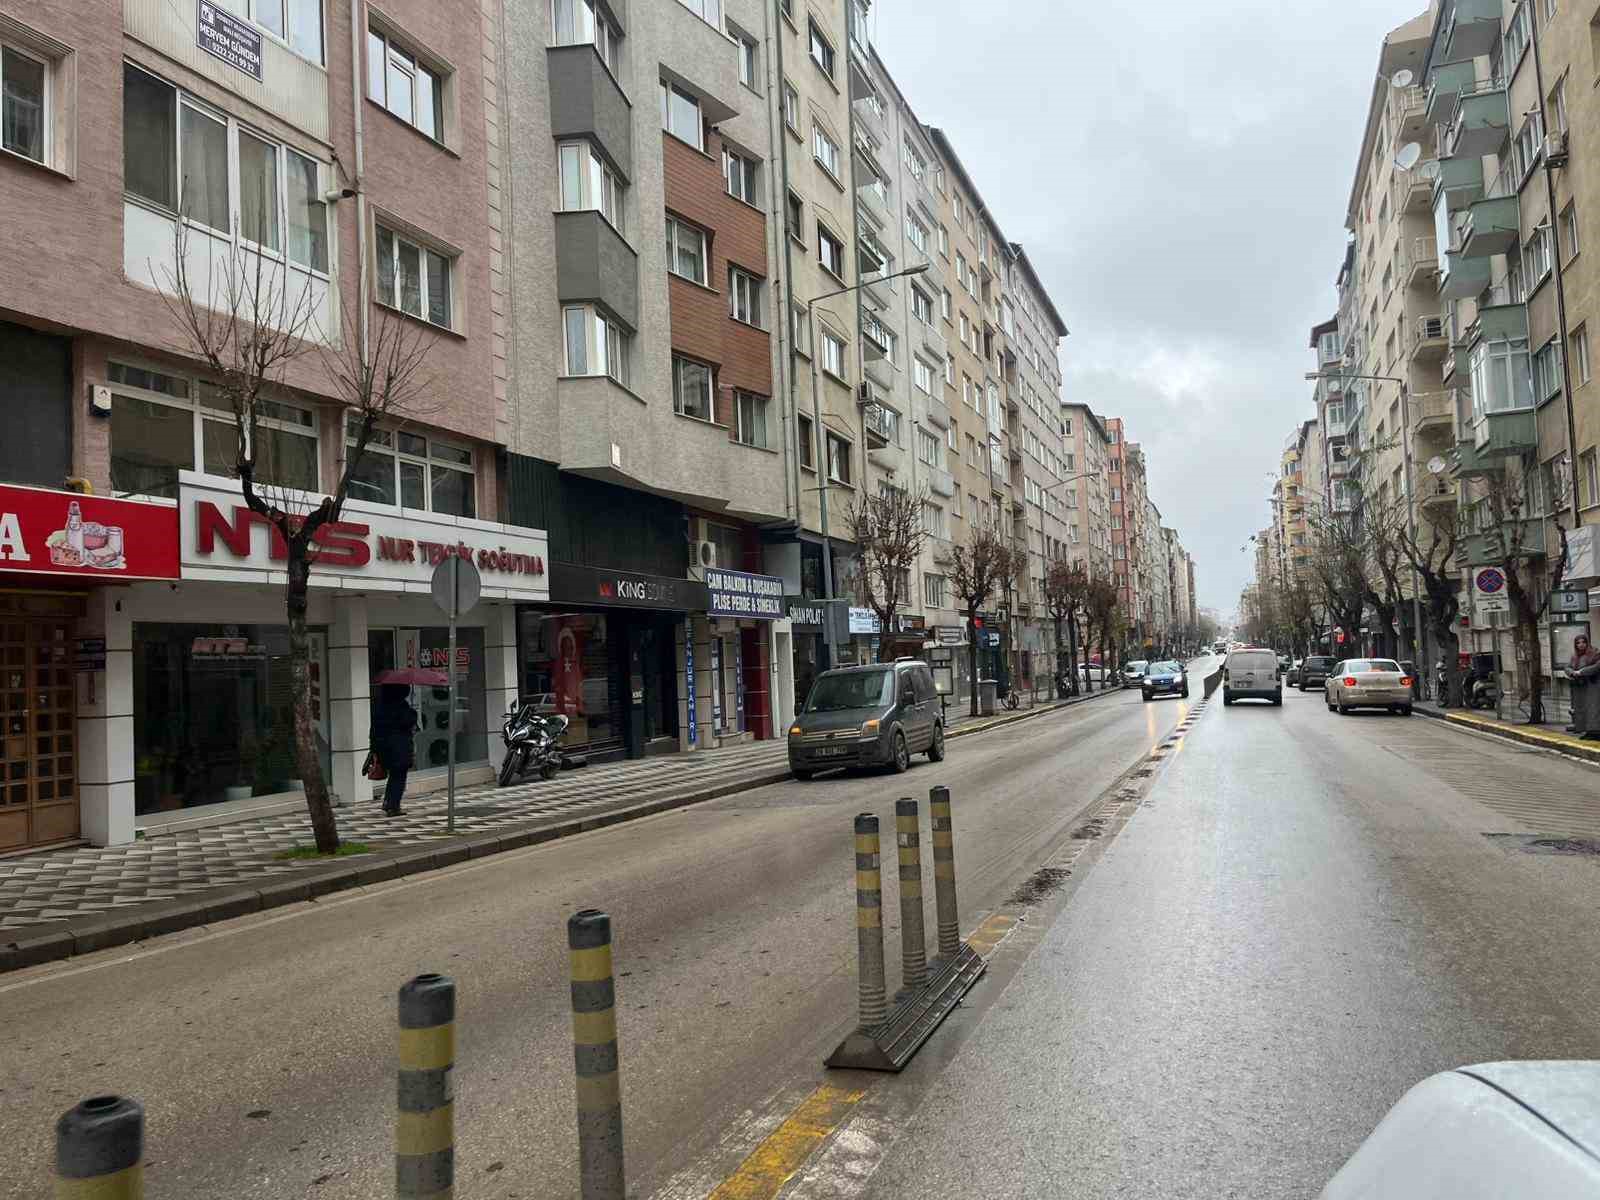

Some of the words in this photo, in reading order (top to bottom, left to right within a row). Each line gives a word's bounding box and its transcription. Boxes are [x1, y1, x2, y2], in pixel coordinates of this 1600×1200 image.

[199, 22, 230, 48] MERYEM
[230, 39, 260, 65] GÜNDEM
[377, 535, 415, 563] NUR
[477, 546, 544, 576] SOĞUTMA
[723, 574, 747, 592] BALKON
[747, 578, 753, 593] &
[731, 595, 751, 612] PERDE
